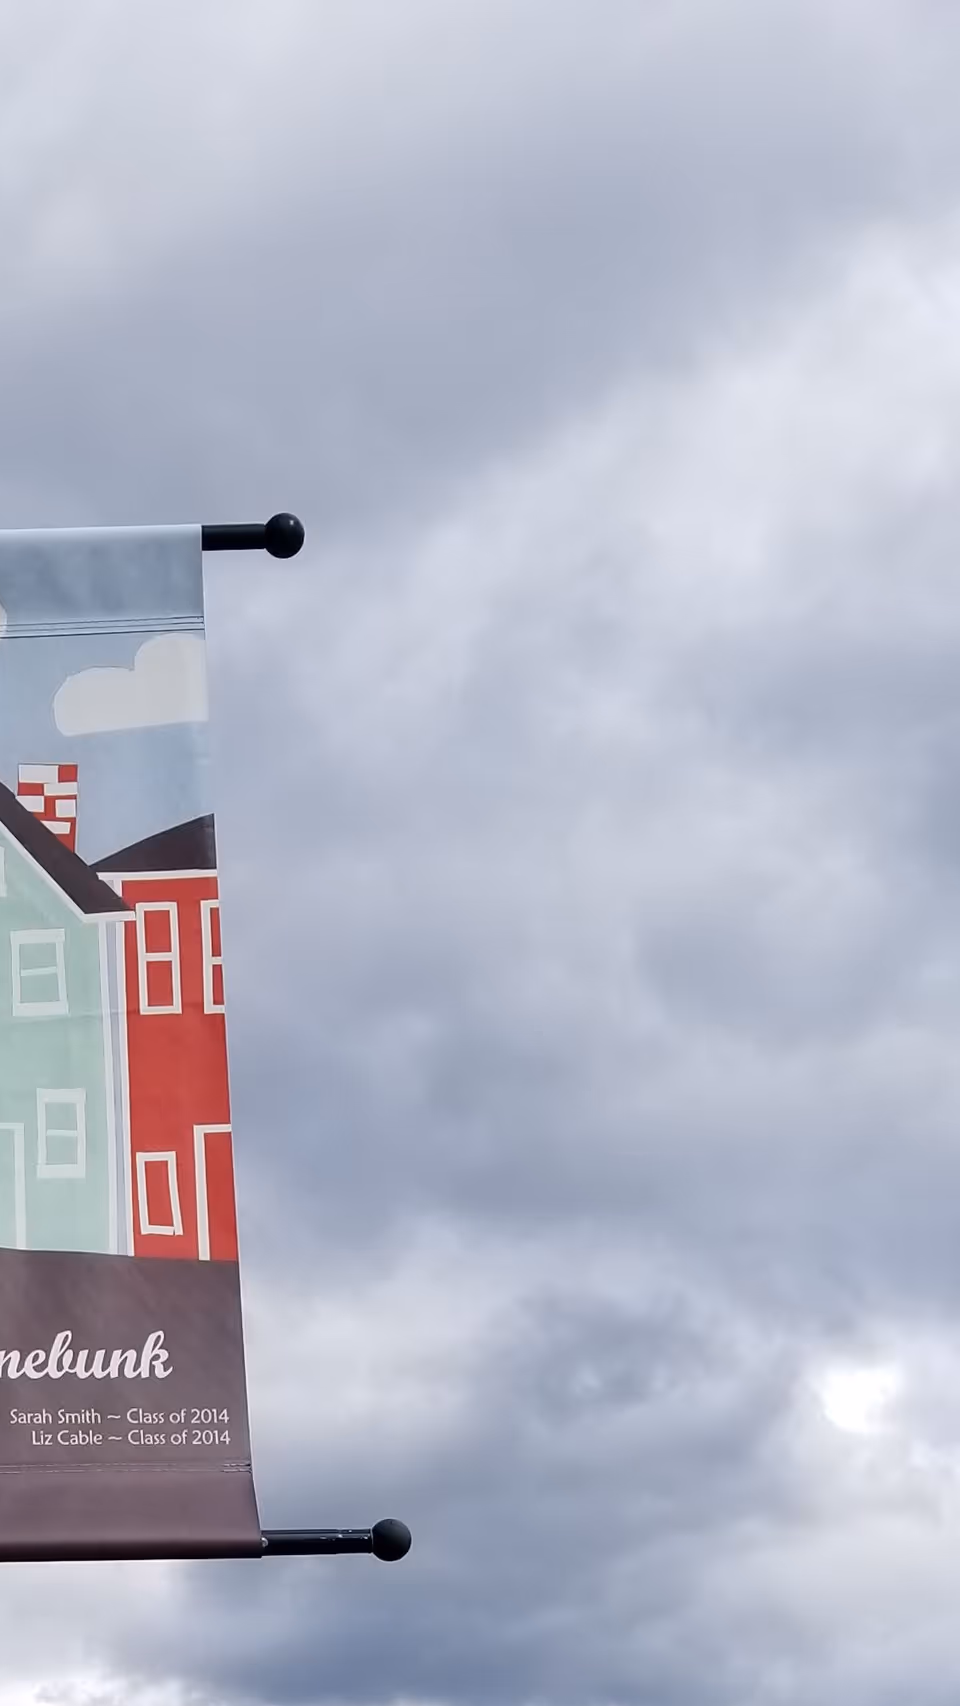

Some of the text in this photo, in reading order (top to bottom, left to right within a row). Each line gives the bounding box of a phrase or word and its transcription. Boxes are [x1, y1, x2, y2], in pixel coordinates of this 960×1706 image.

[10, 1408, 52, 1424] Sarah
[57, 1408, 101, 1424] Smith
[126, 1408, 164, 1424] Class
[169, 1408, 186, 1424] of
[191, 1408, 230, 1424] 2014
[32, 1430, 52, 1445] Liz
[57, 1430, 102, 1445] Cable
[128, 1430, 166, 1445] Class
[170, 1429, 188, 1445] of
[192, 1430, 231, 1445] 2014
